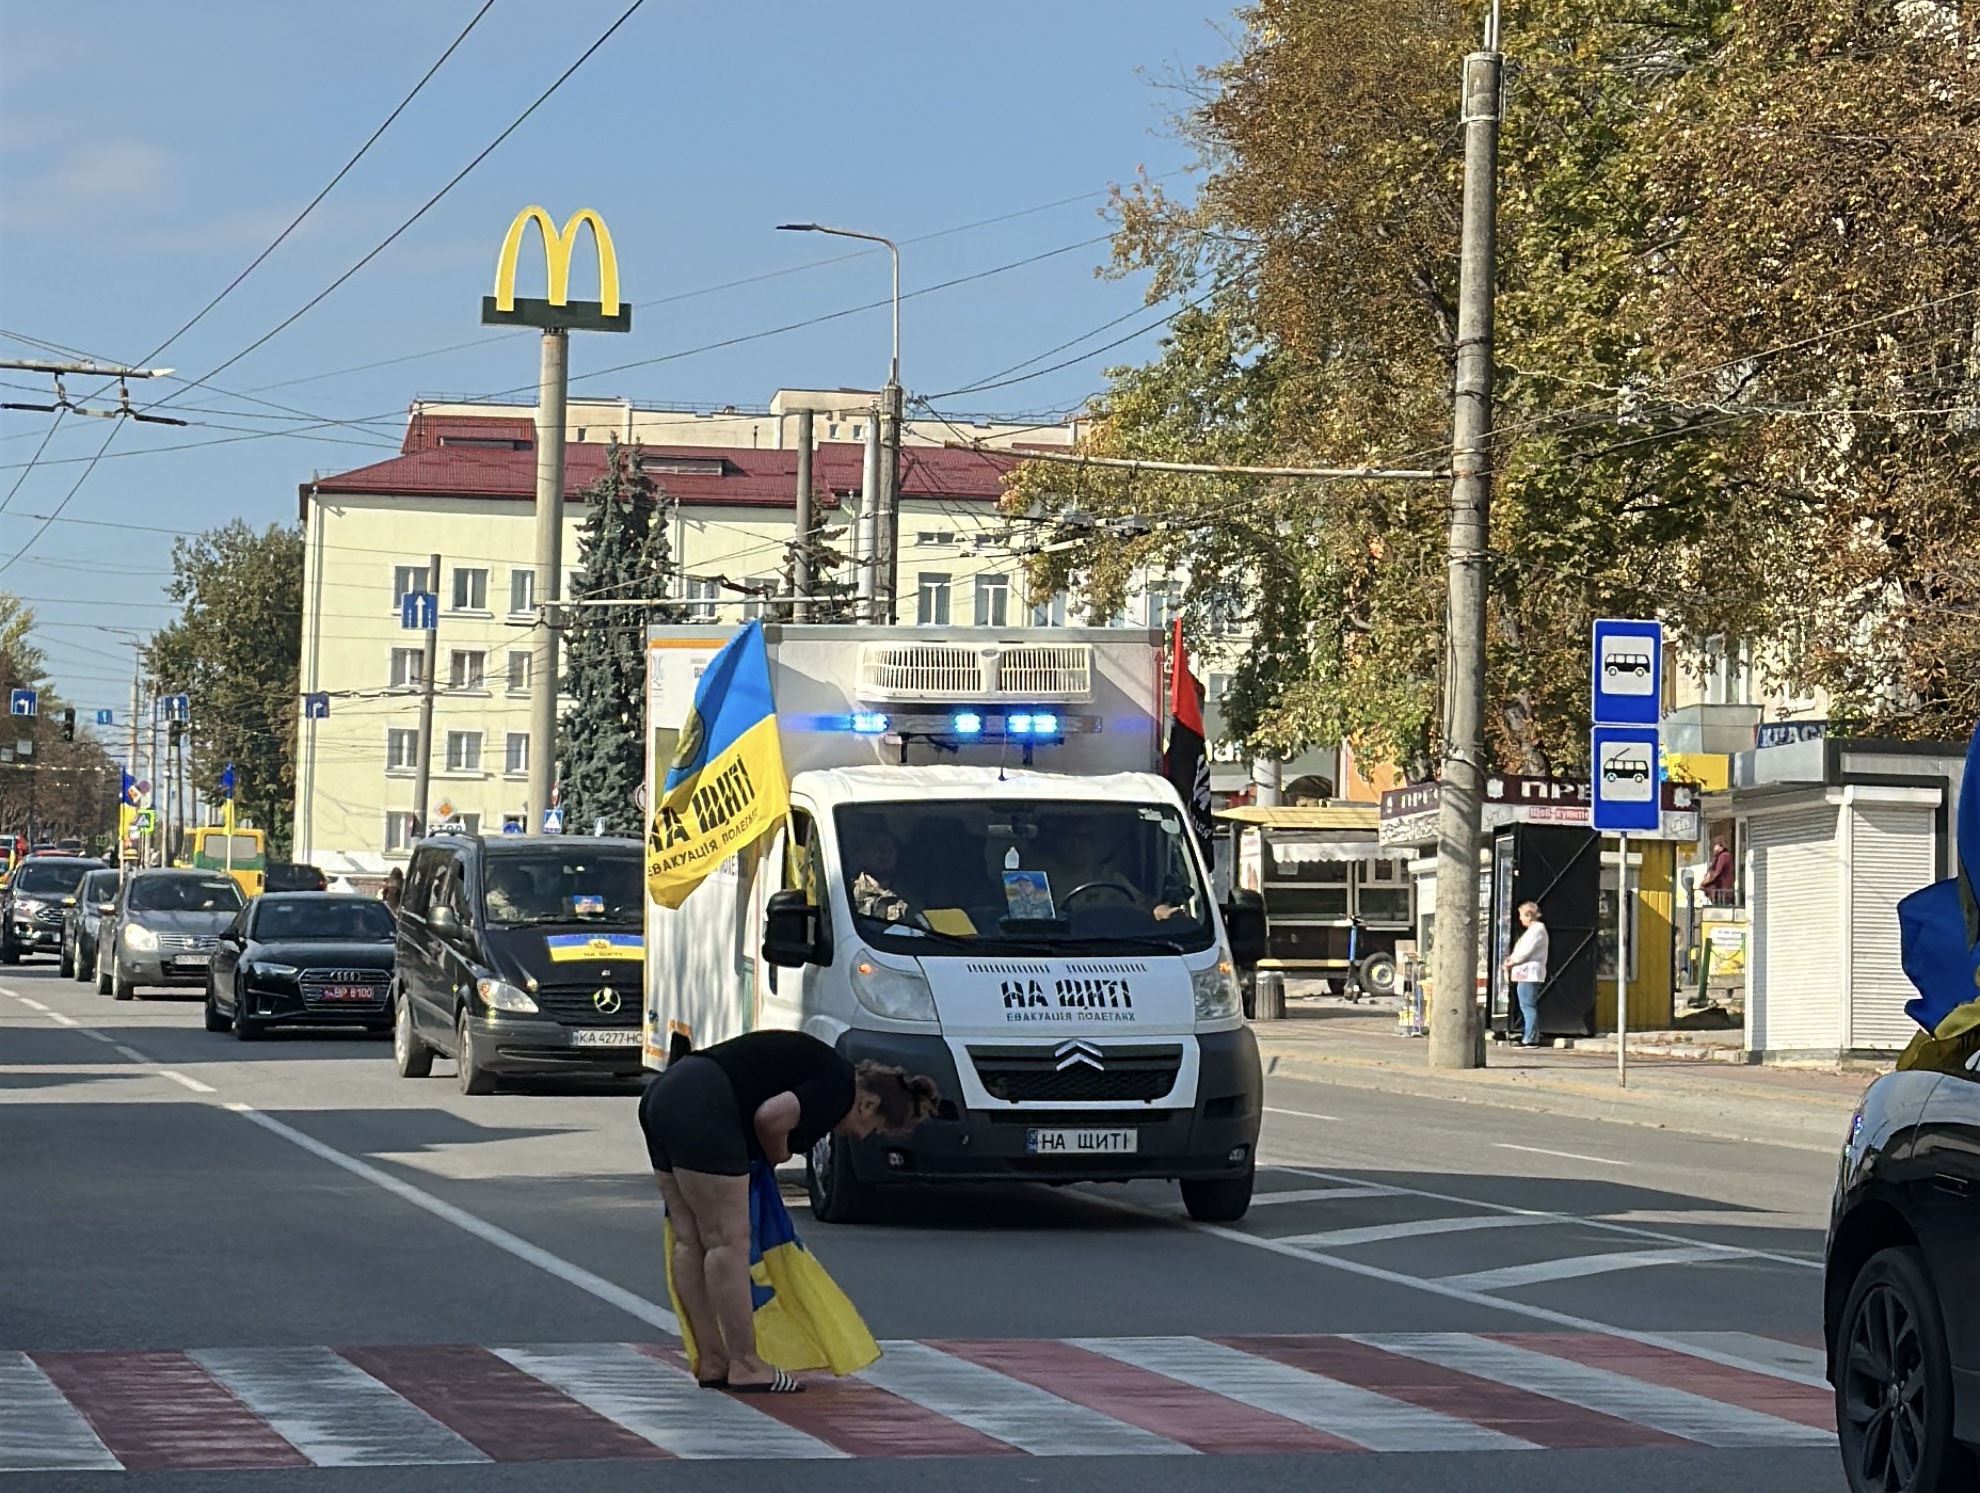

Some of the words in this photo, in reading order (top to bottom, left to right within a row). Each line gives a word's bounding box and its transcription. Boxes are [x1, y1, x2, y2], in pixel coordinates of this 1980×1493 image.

[691, 754, 755, 834] ЩИТІ
[1001, 979, 1049, 1008] НА
[1055, 978, 1133, 1010] ЩИТІ
[1007, 1012, 1072, 1022] ЕВАКУАЦІЯ
[580, 1032, 597, 1044] KA
[598, 1032, 625, 1044] 4277
[1042, 1133, 1066, 1150] НА
[1078, 1132, 1128, 1150] ЩИТІ
